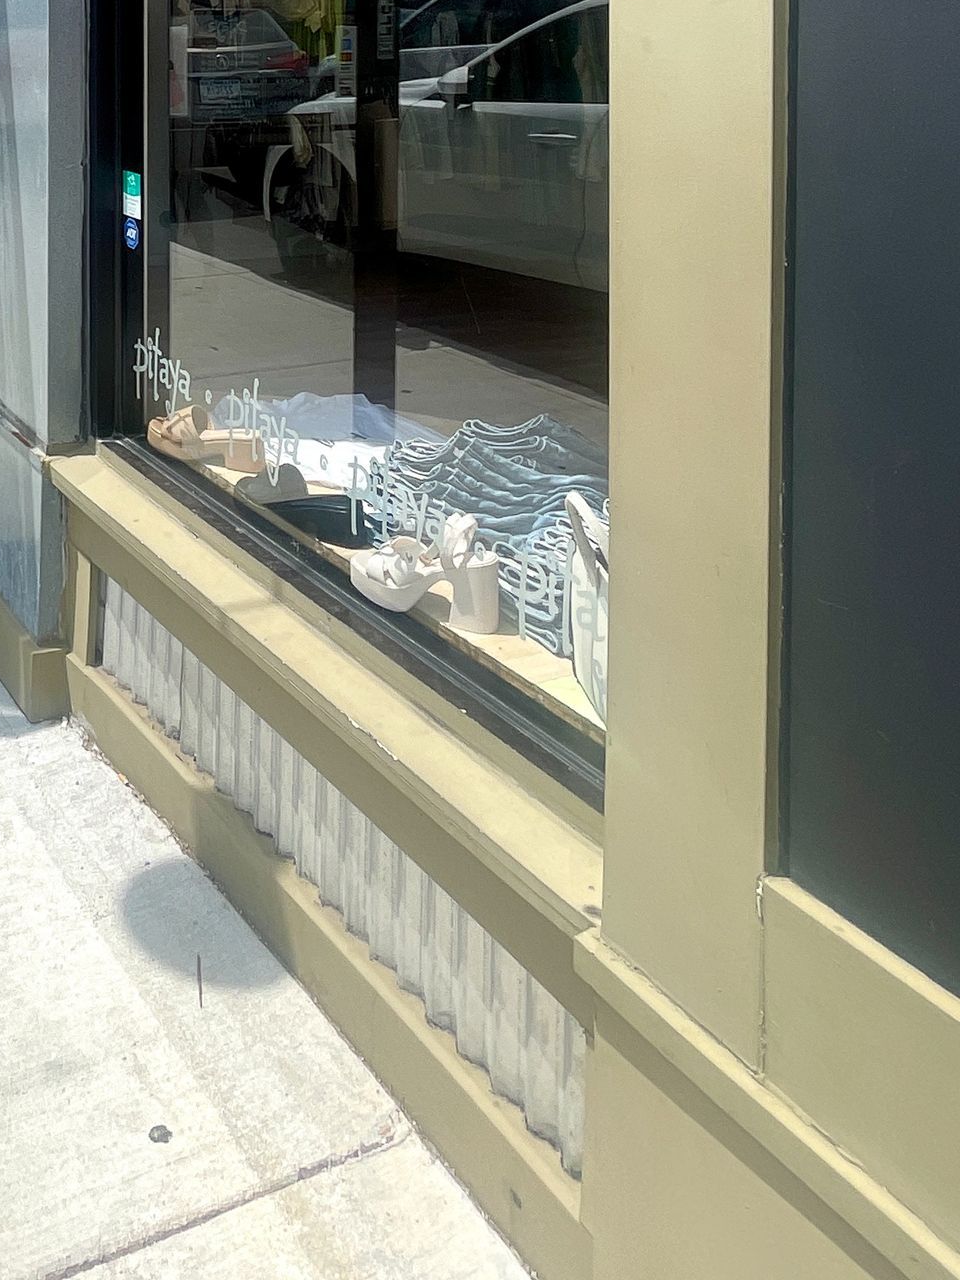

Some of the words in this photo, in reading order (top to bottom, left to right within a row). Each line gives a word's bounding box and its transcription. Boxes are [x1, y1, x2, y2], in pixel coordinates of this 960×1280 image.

[133, 327, 192, 420] pitaya
[224, 378, 301, 487] pitaya
[346, 445, 447, 565] pitaya
